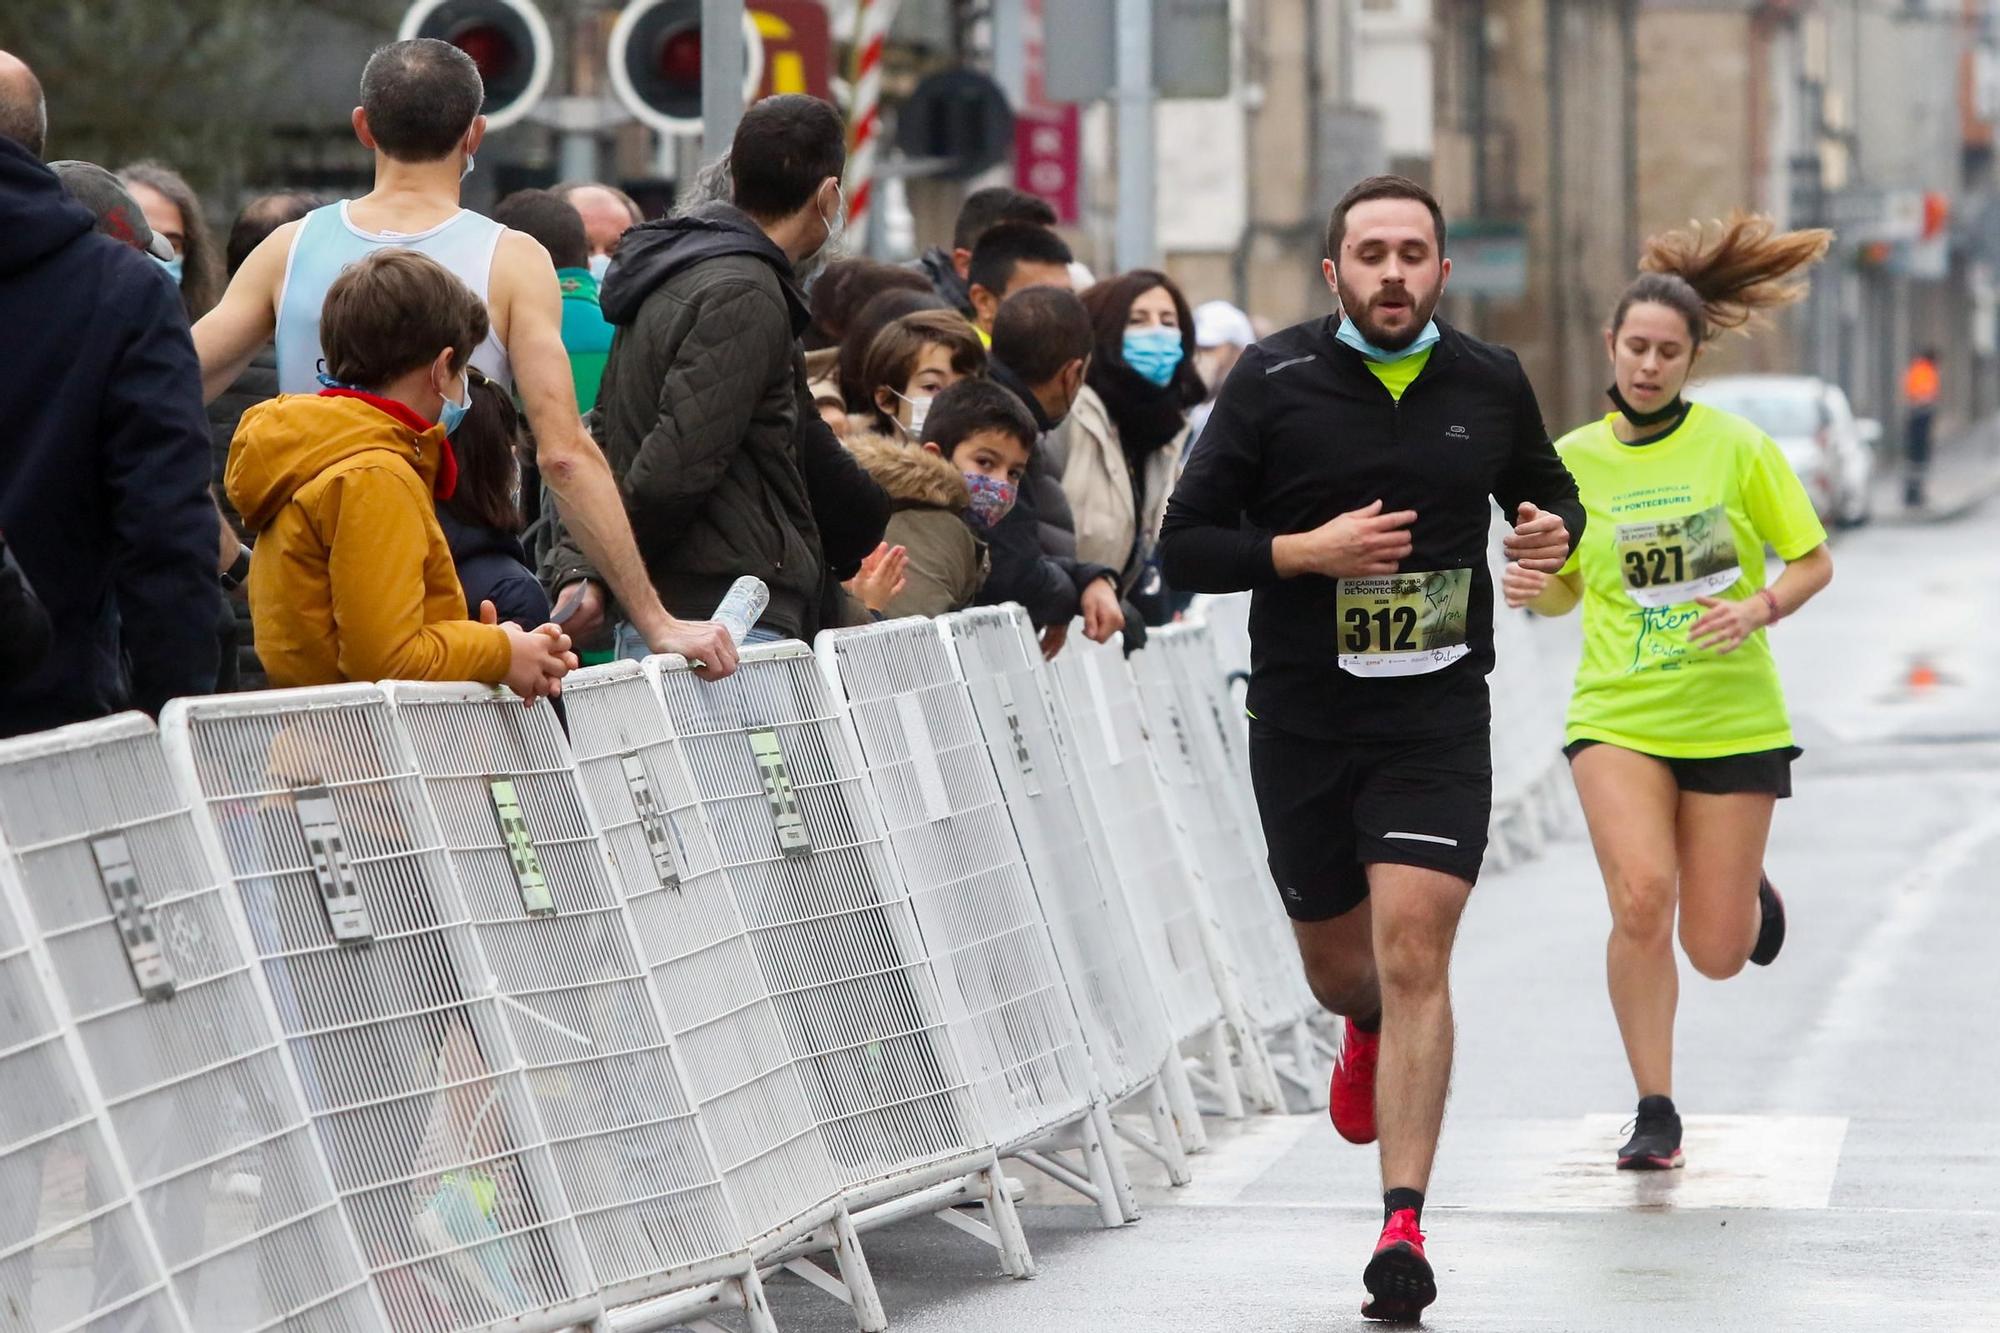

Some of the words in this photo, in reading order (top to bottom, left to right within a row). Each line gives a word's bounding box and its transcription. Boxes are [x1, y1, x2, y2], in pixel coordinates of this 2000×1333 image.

[1611, 505, 1622, 513] DE
[1624, 496, 1692, 511] PONTECESURES
[1625, 545, 1684, 589] 327
[1344, 587, 1356, 595] DE
[1344, 606, 1418, 652] 312
